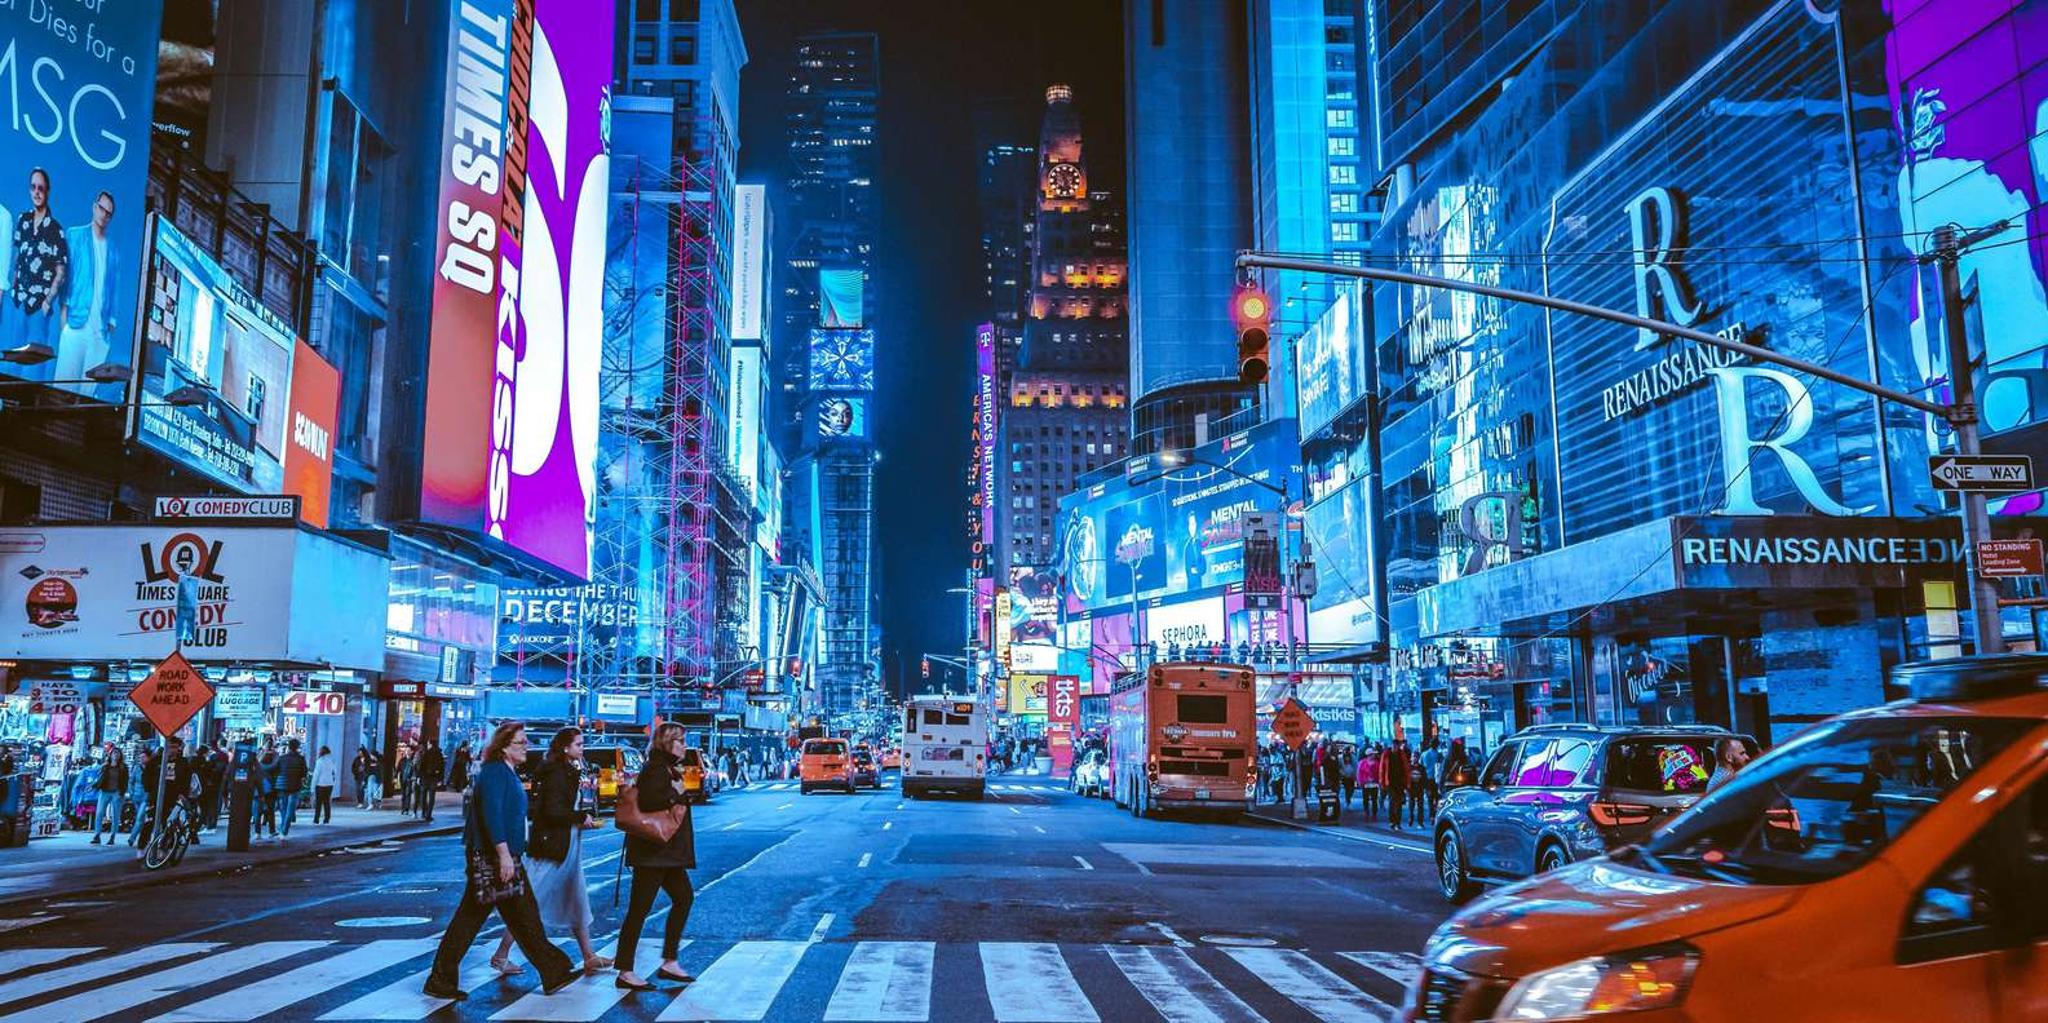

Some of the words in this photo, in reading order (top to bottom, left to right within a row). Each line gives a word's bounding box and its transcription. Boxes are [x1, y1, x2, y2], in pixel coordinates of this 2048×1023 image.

[29, 0, 78, 44] Dies
[85, 23, 116, 63] for
[121, 55, 136, 77] a
[451, 2, 508, 196] TIMES
[439, 200, 497, 295] SQ
[1624, 185, 1703, 352] R
[1603, 322, 1744, 421] RENAISSANCE
[488, 256, 523, 540] KISS
[981, 374, 994, 441] AMERICA'S
[1704, 366, 1877, 517] R
[984, 445, 995, 508] NETWORK
[1943, 466, 1975, 480] ONE
[1990, 466, 2023, 481] WAY
[159, 497, 190, 518] LOL
[1211, 499, 1258, 525] MENTAL
[140, 532, 224, 585] LOL
[1683, 536, 1908, 564] RENAISSANCE
[1981, 543, 1993, 552] NO
[1994, 542, 2031, 552] STANDING
[135, 581, 176, 601] TIMES
[139, 603, 227, 631] CODY
[505, 598, 638, 628] DECEMBER
[1162, 623, 1208, 644] SEPHORA
[156, 682, 186, 692] WORK
[159, 669, 189, 680] ROAD
[150, 694, 190, 705] AHEAD
[220, 697, 260, 705] LUGGAGE
[1055, 679, 1075, 718] tkts
[1312, 707, 1356, 721] ktstkts
